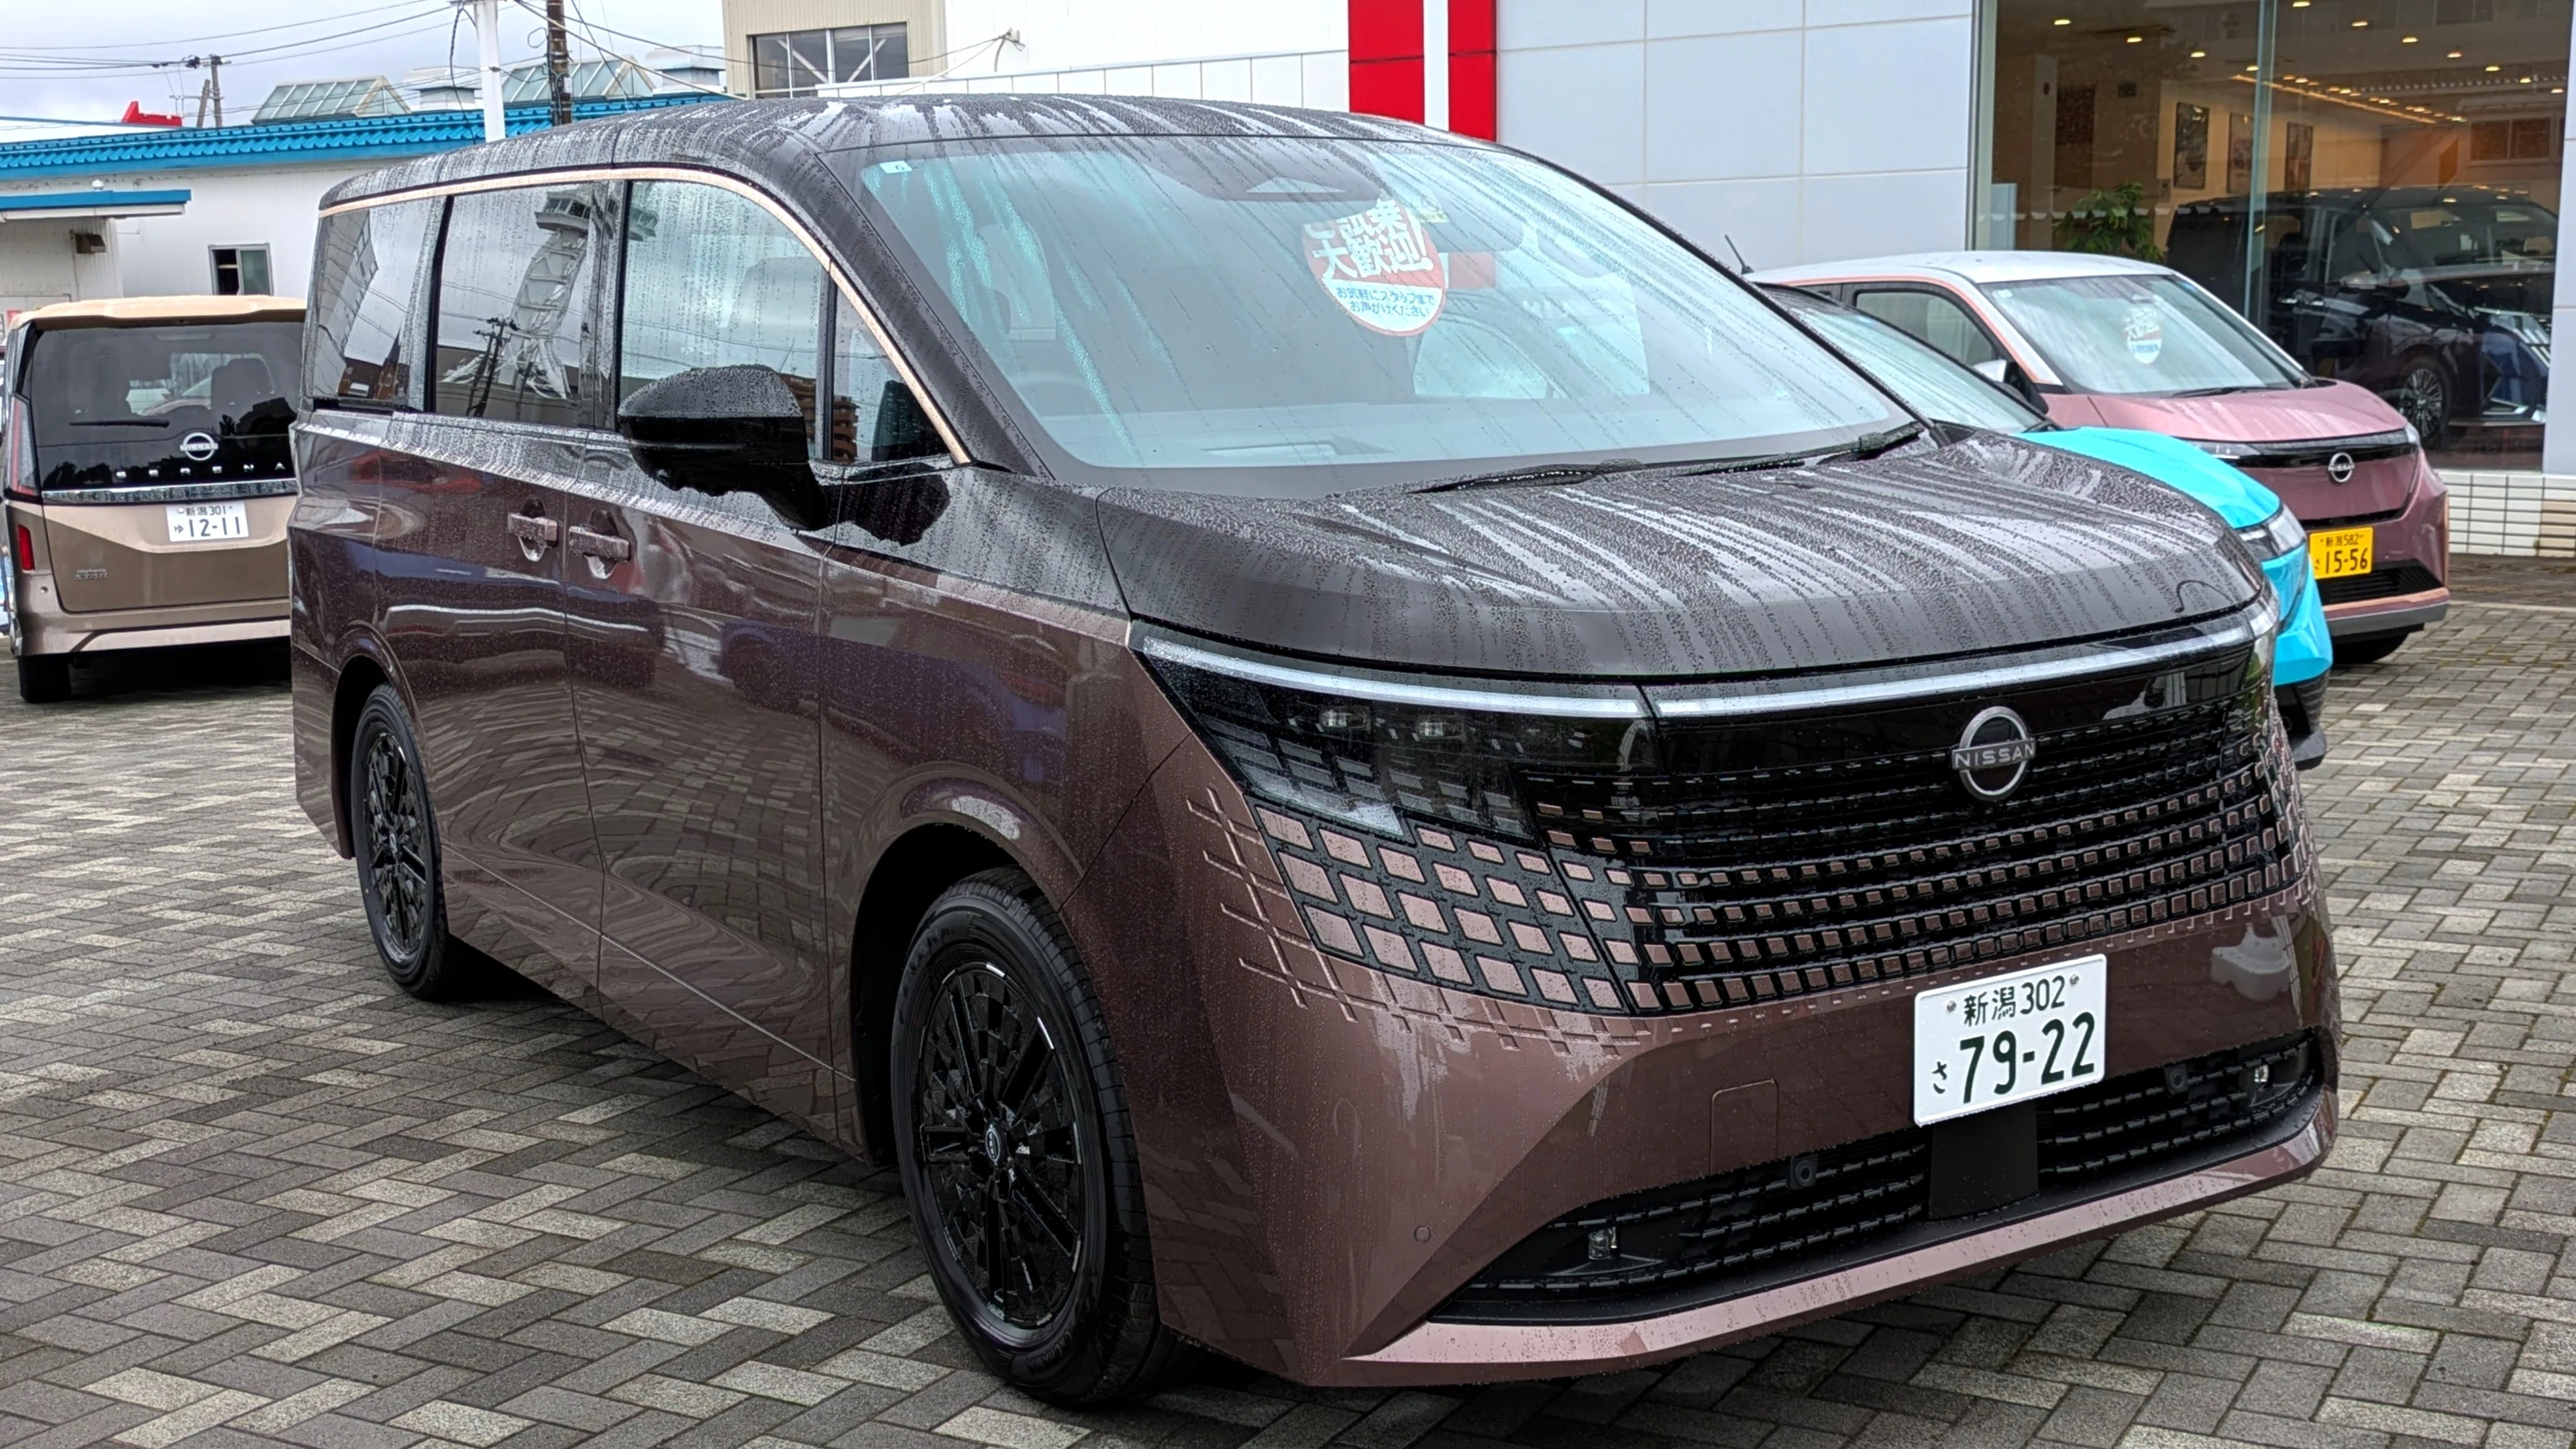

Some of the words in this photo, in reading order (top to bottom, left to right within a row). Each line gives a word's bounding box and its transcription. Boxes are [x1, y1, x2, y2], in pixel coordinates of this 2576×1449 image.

[1336, 287, 1436, 305] お気軽にスタッフまで
[1350, 301, 1431, 317] お声がけください
[180, 443, 218, 451] NISSAN
[116, 462, 286, 478] SERENA
[189, 517, 241, 537] 12-11
[2325, 547, 2368, 574] 15-56
[1954, 743, 2035, 768] NISSAN
[1931, 1061, 1947, 1095] さ
[1959, 1011, 2095, 1104] 79-22
